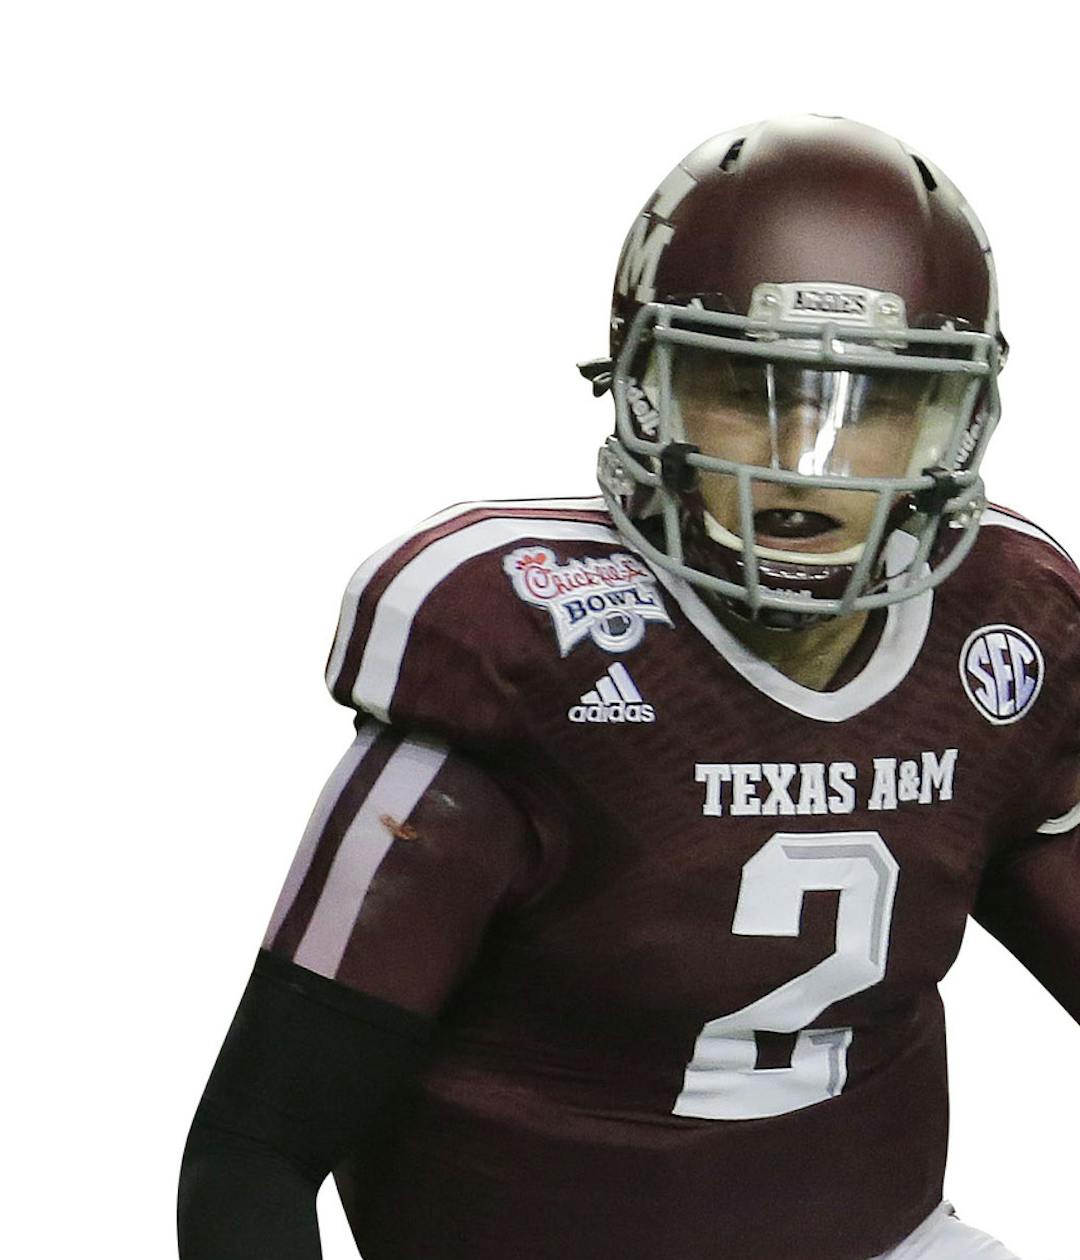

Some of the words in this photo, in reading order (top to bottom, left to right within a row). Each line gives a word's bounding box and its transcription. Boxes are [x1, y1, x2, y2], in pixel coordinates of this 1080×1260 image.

[562, 587, 657, 625] BOWL
[966, 632, 1036, 717] SEC
[567, 702, 657, 723] adidas
[695, 762, 856, 816] TEXAS
[868, 748, 959, 810] A&M
[672, 831, 901, 1120] 2
